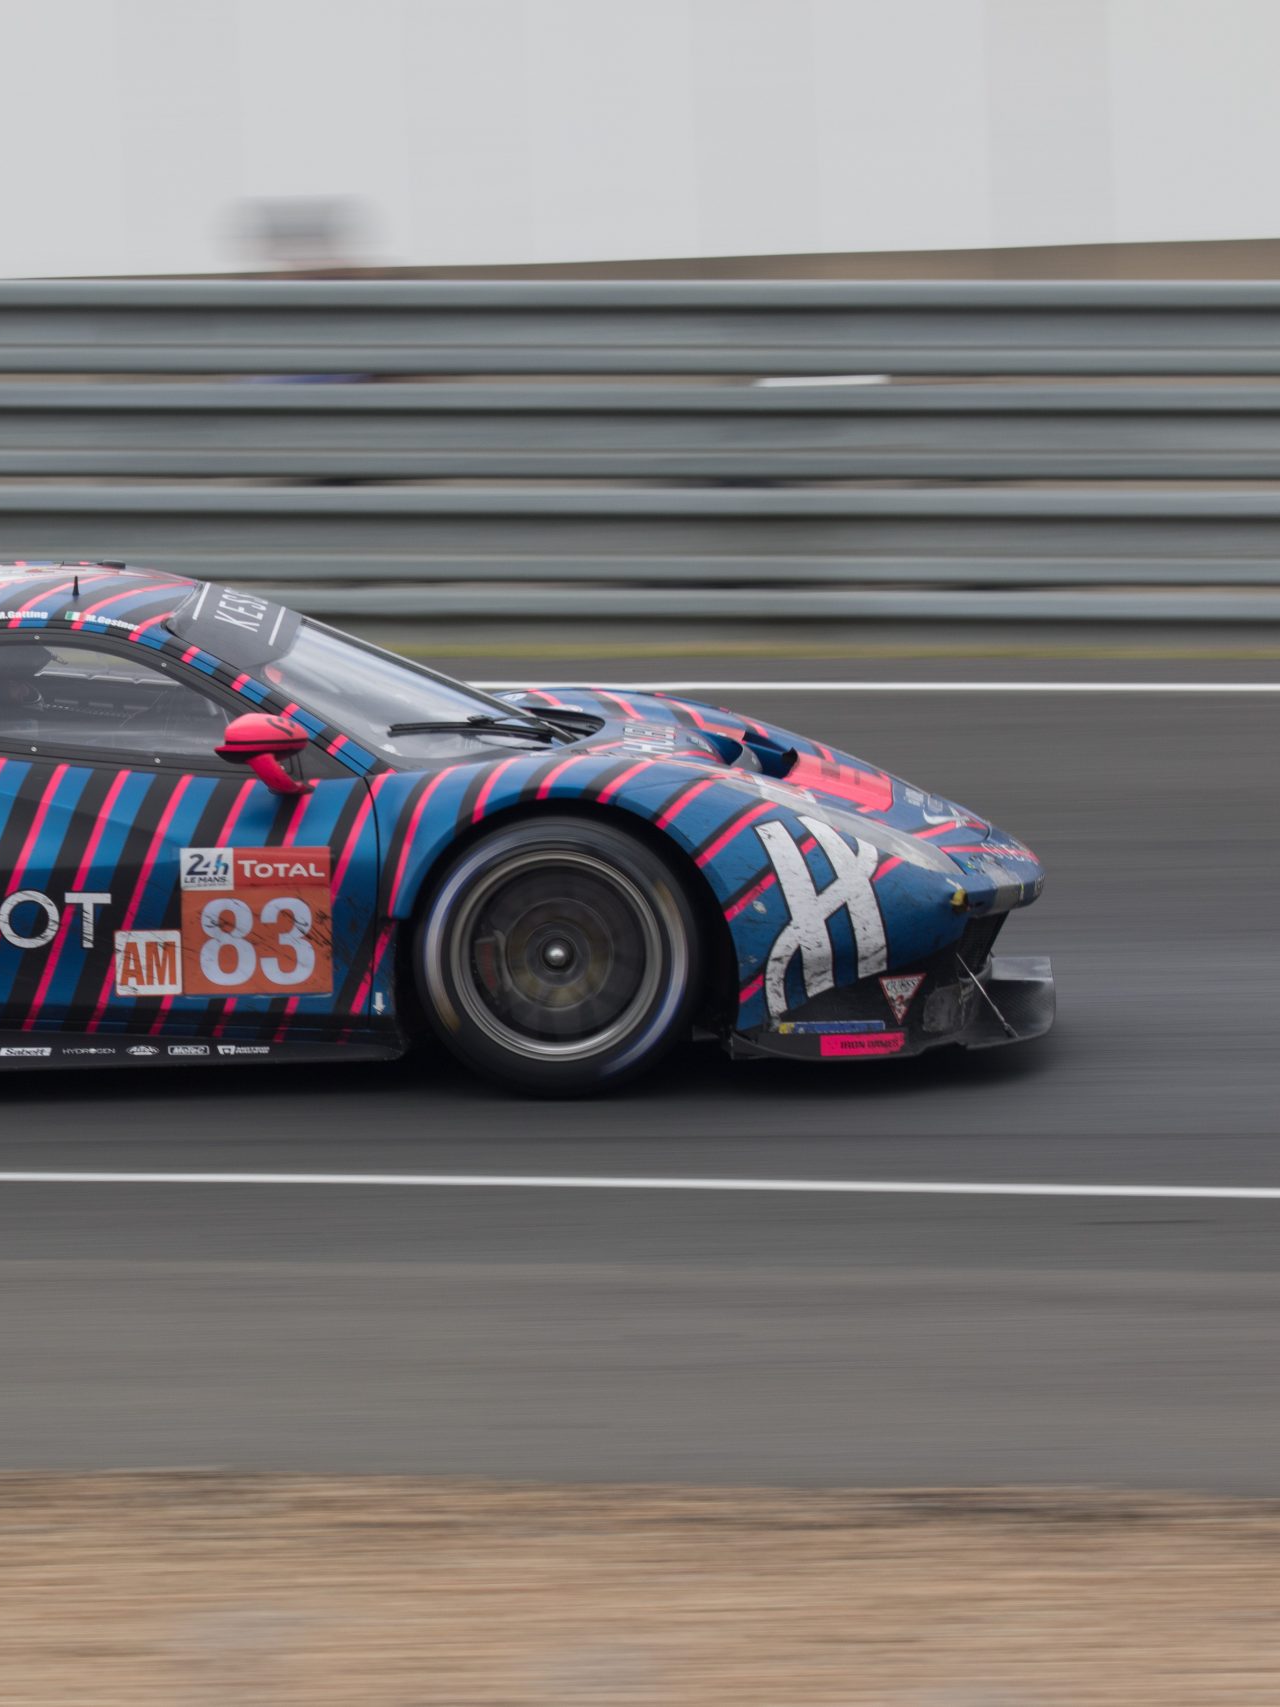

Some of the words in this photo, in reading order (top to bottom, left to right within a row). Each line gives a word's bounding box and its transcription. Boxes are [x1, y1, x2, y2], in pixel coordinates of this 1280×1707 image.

[237, 860, 326, 879] TOTAL
[197, 876, 227, 884] MANS
[200, 897, 316, 986] 83
[119, 940, 177, 987] AM
[62, 1047, 116, 1055] HYDROGEN
[840, 1040, 865, 1050] IRON
